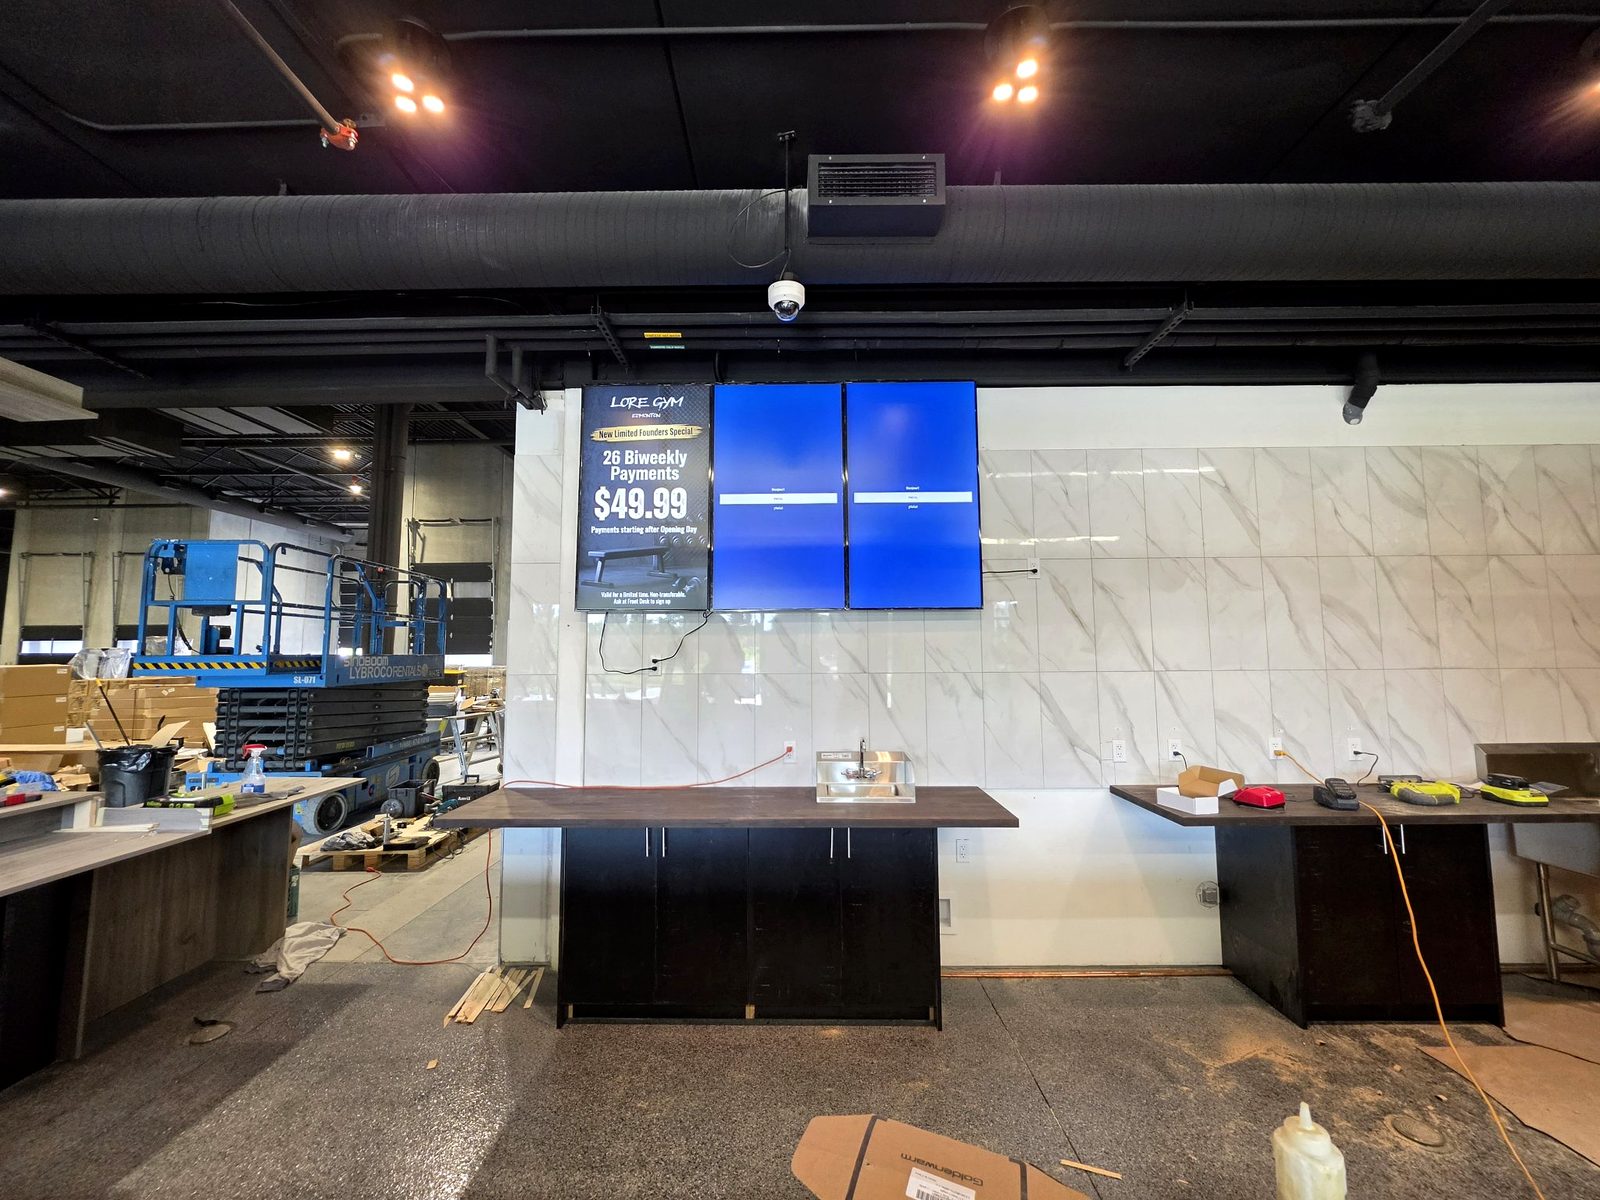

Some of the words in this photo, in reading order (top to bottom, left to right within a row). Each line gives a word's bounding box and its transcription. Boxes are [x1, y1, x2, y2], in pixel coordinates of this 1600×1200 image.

[610, 397, 649, 409] LORE
[653, 397, 684, 410] GYM
[599, 431, 613, 439] New
[614, 429, 638, 438] Limited
[639, 428, 669, 437] Founders
[669, 427, 693, 437] Special
[603, 450, 621, 465] 26
[624, 449, 688, 468] Biweekly
[610, 466, 680, 484] Payments
[594, 486, 687, 521] $49.99
[591, 526, 620, 534] Payments
[620, 526, 644, 534] starting
[645, 526, 660, 534] after
[660, 526, 685, 534] Opening
[685, 526, 698, 534] Day
[293, 675, 316, 684] SL-071
[900, 1153, 983, 1186] Goldenwarm
